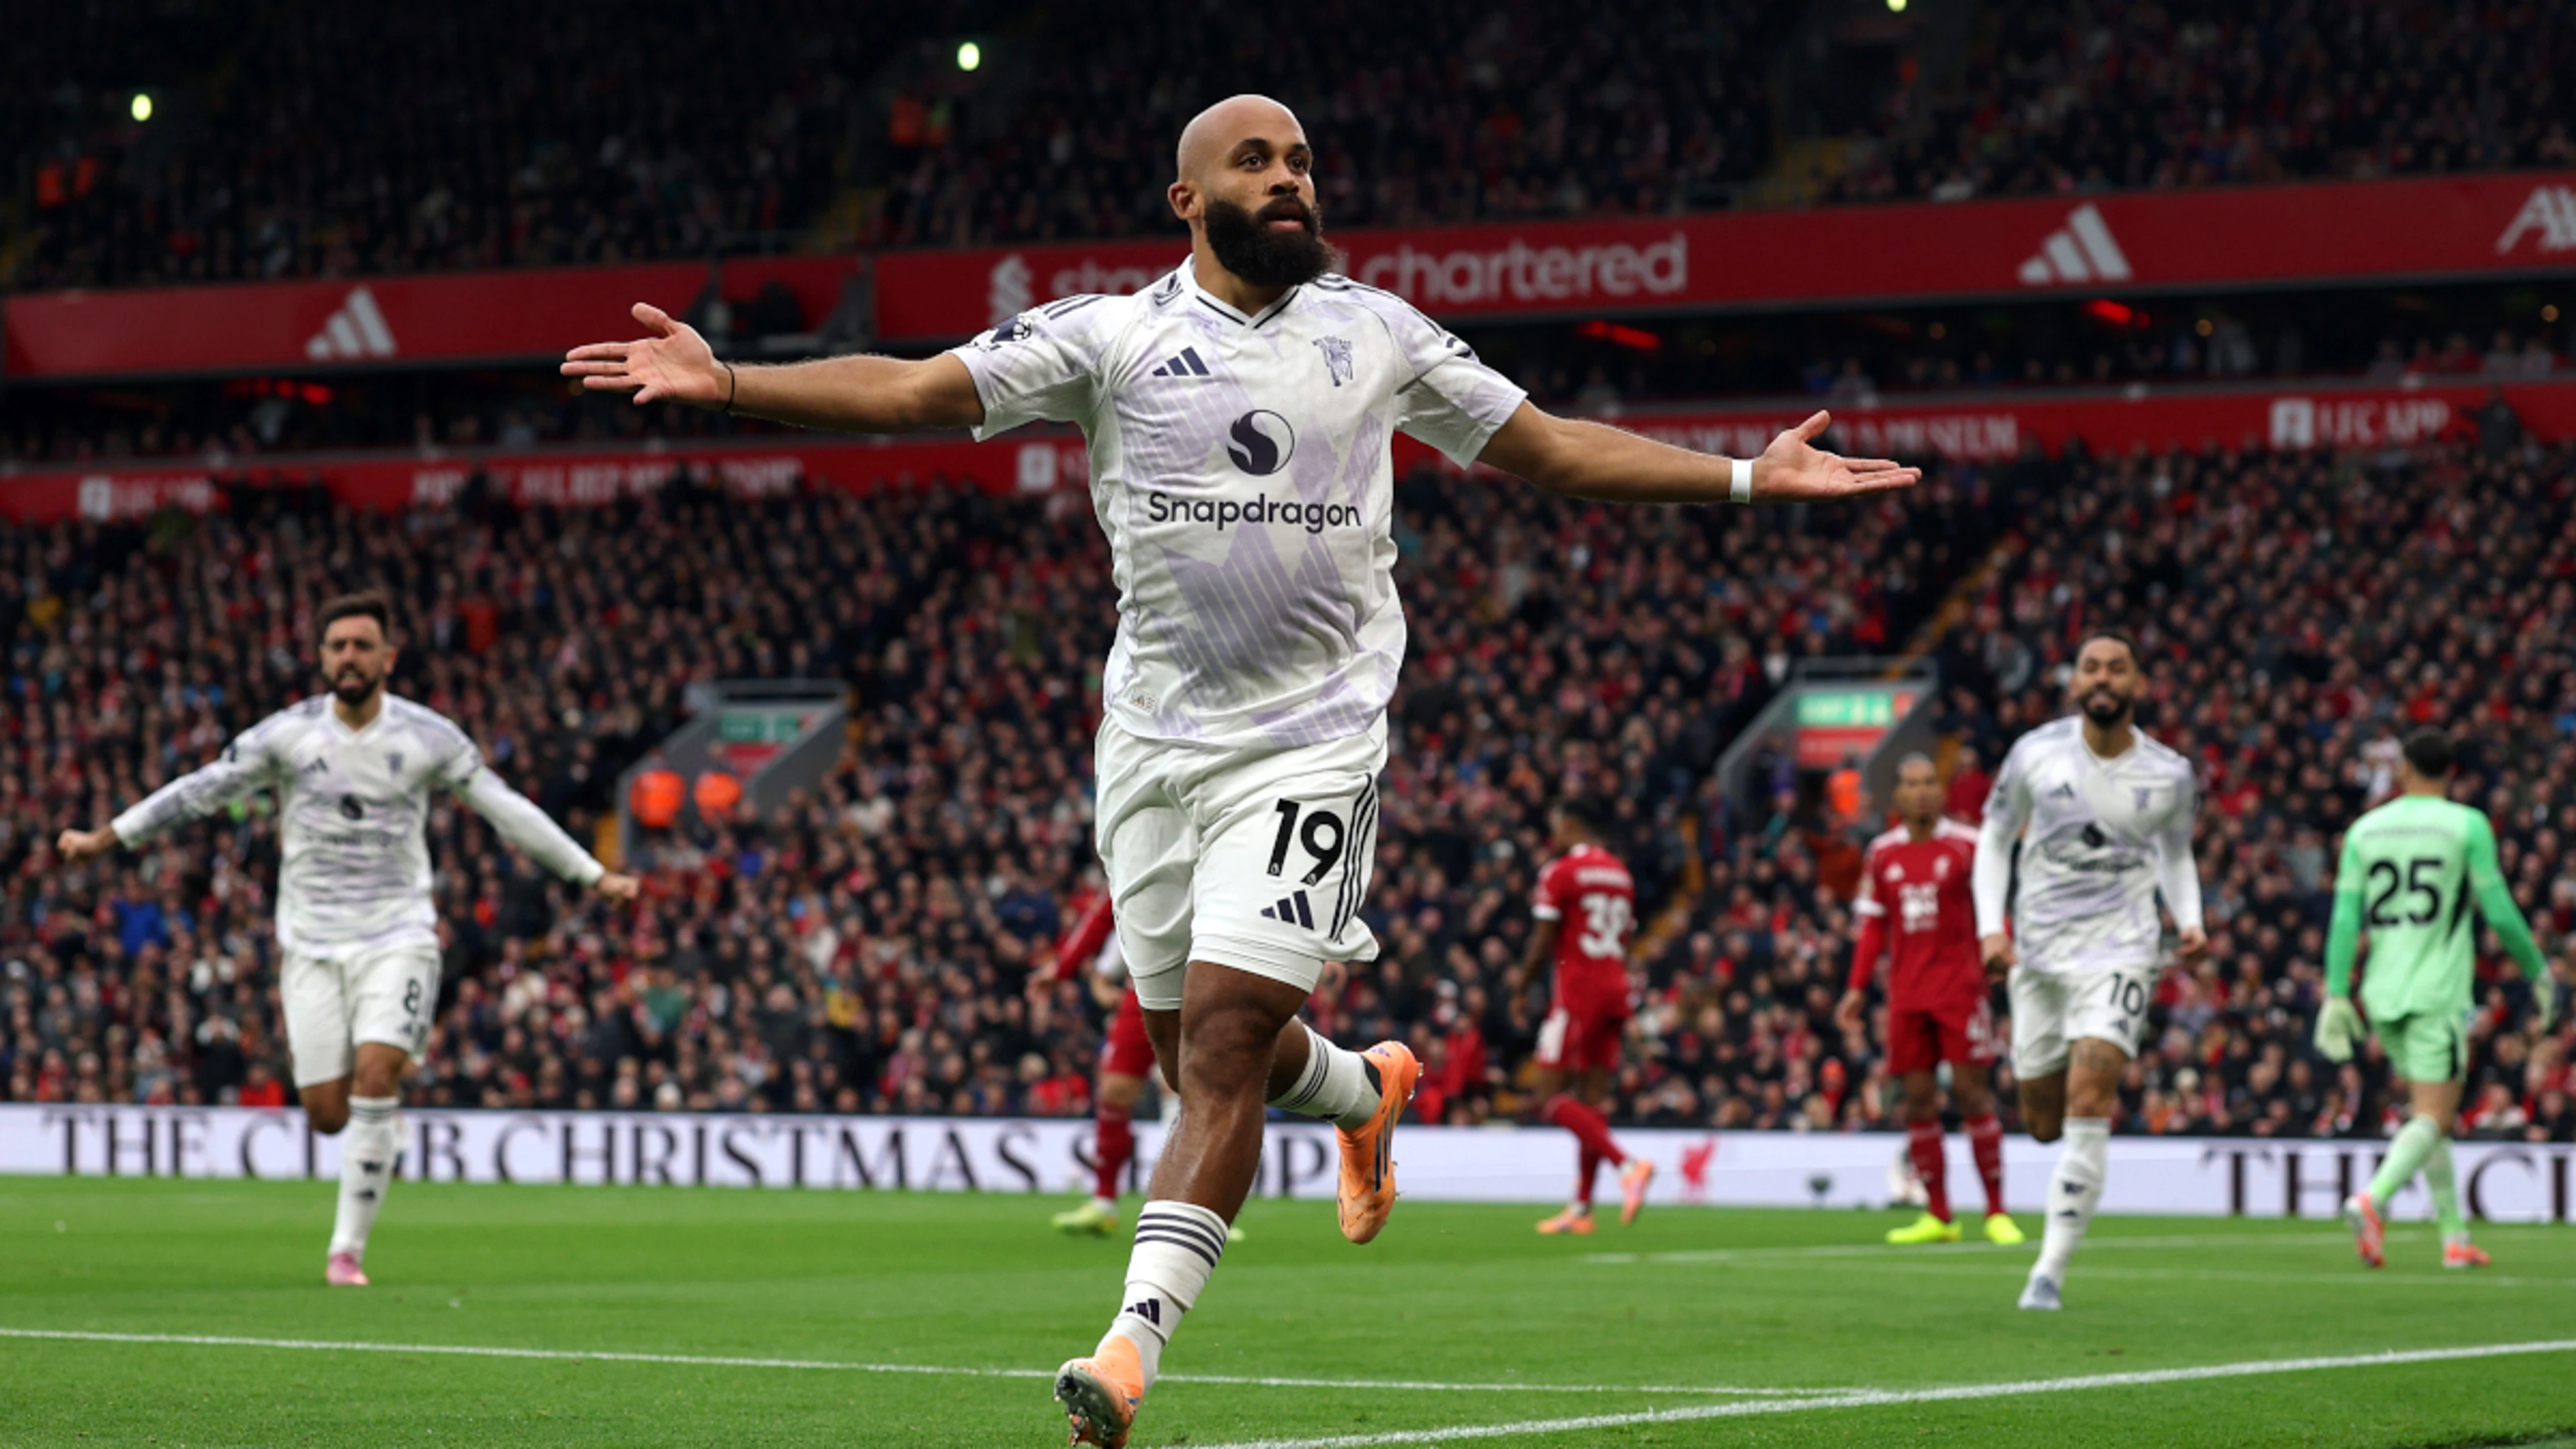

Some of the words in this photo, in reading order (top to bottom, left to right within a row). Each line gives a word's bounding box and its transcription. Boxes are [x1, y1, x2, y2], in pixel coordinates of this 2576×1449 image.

[1360, 231, 1686, 303] chartered
[1148, 491, 1362, 534] Snapdragon
[1267, 798, 1344, 887] 19
[2369, 857, 2443, 926] 25
[402, 978, 422, 1016] 8
[2109, 972, 2145, 1017] 10
[42, 1108, 217, 1176] THE
[240, 1111, 466, 1180] CLB
[493, 1115, 1038, 1191] CHRISTMAS
[2200, 1139, 2420, 1218] TH
